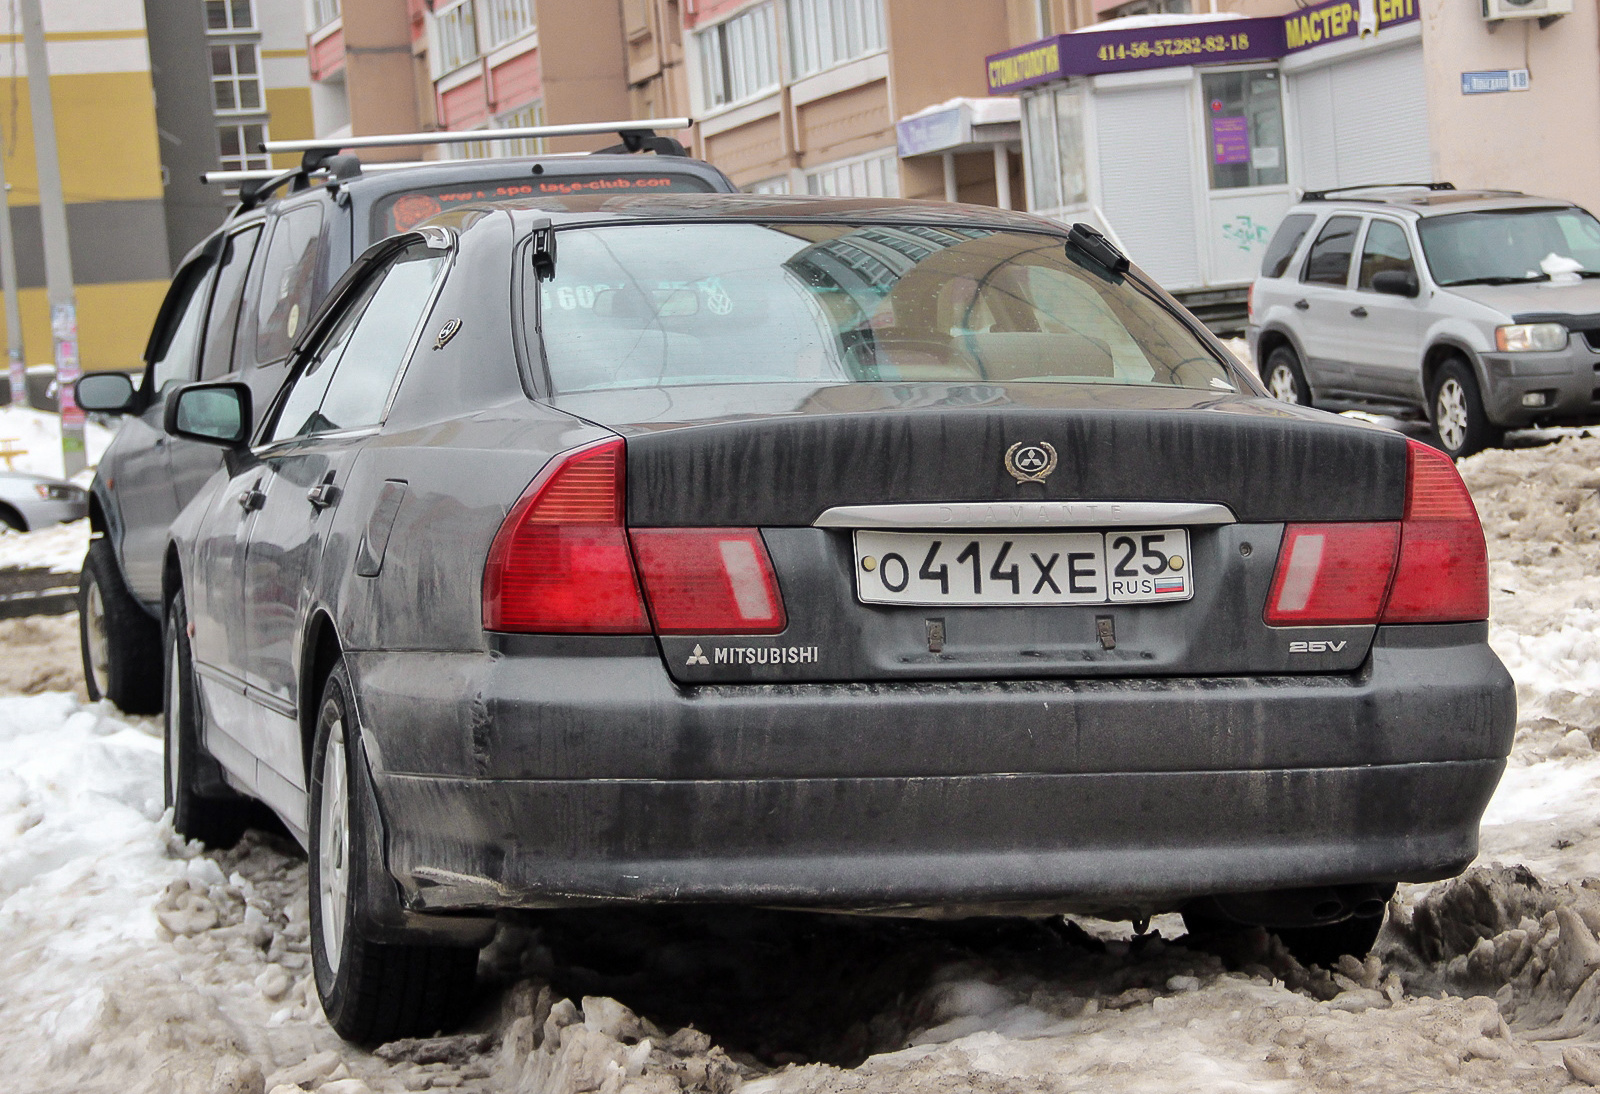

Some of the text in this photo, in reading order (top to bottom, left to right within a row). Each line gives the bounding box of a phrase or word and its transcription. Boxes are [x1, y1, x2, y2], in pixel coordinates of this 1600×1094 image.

[1285, 0, 1413, 49] МАСТЕР-ЕН
[939, 505, 1121, 523] DIAMANTE
[1112, 534, 1168, 577] 25
[1112, 579, 1152, 595] RUS
[714, 646, 818, 664] MITSUBISHI
[1289, 640, 1347, 653] 25V
